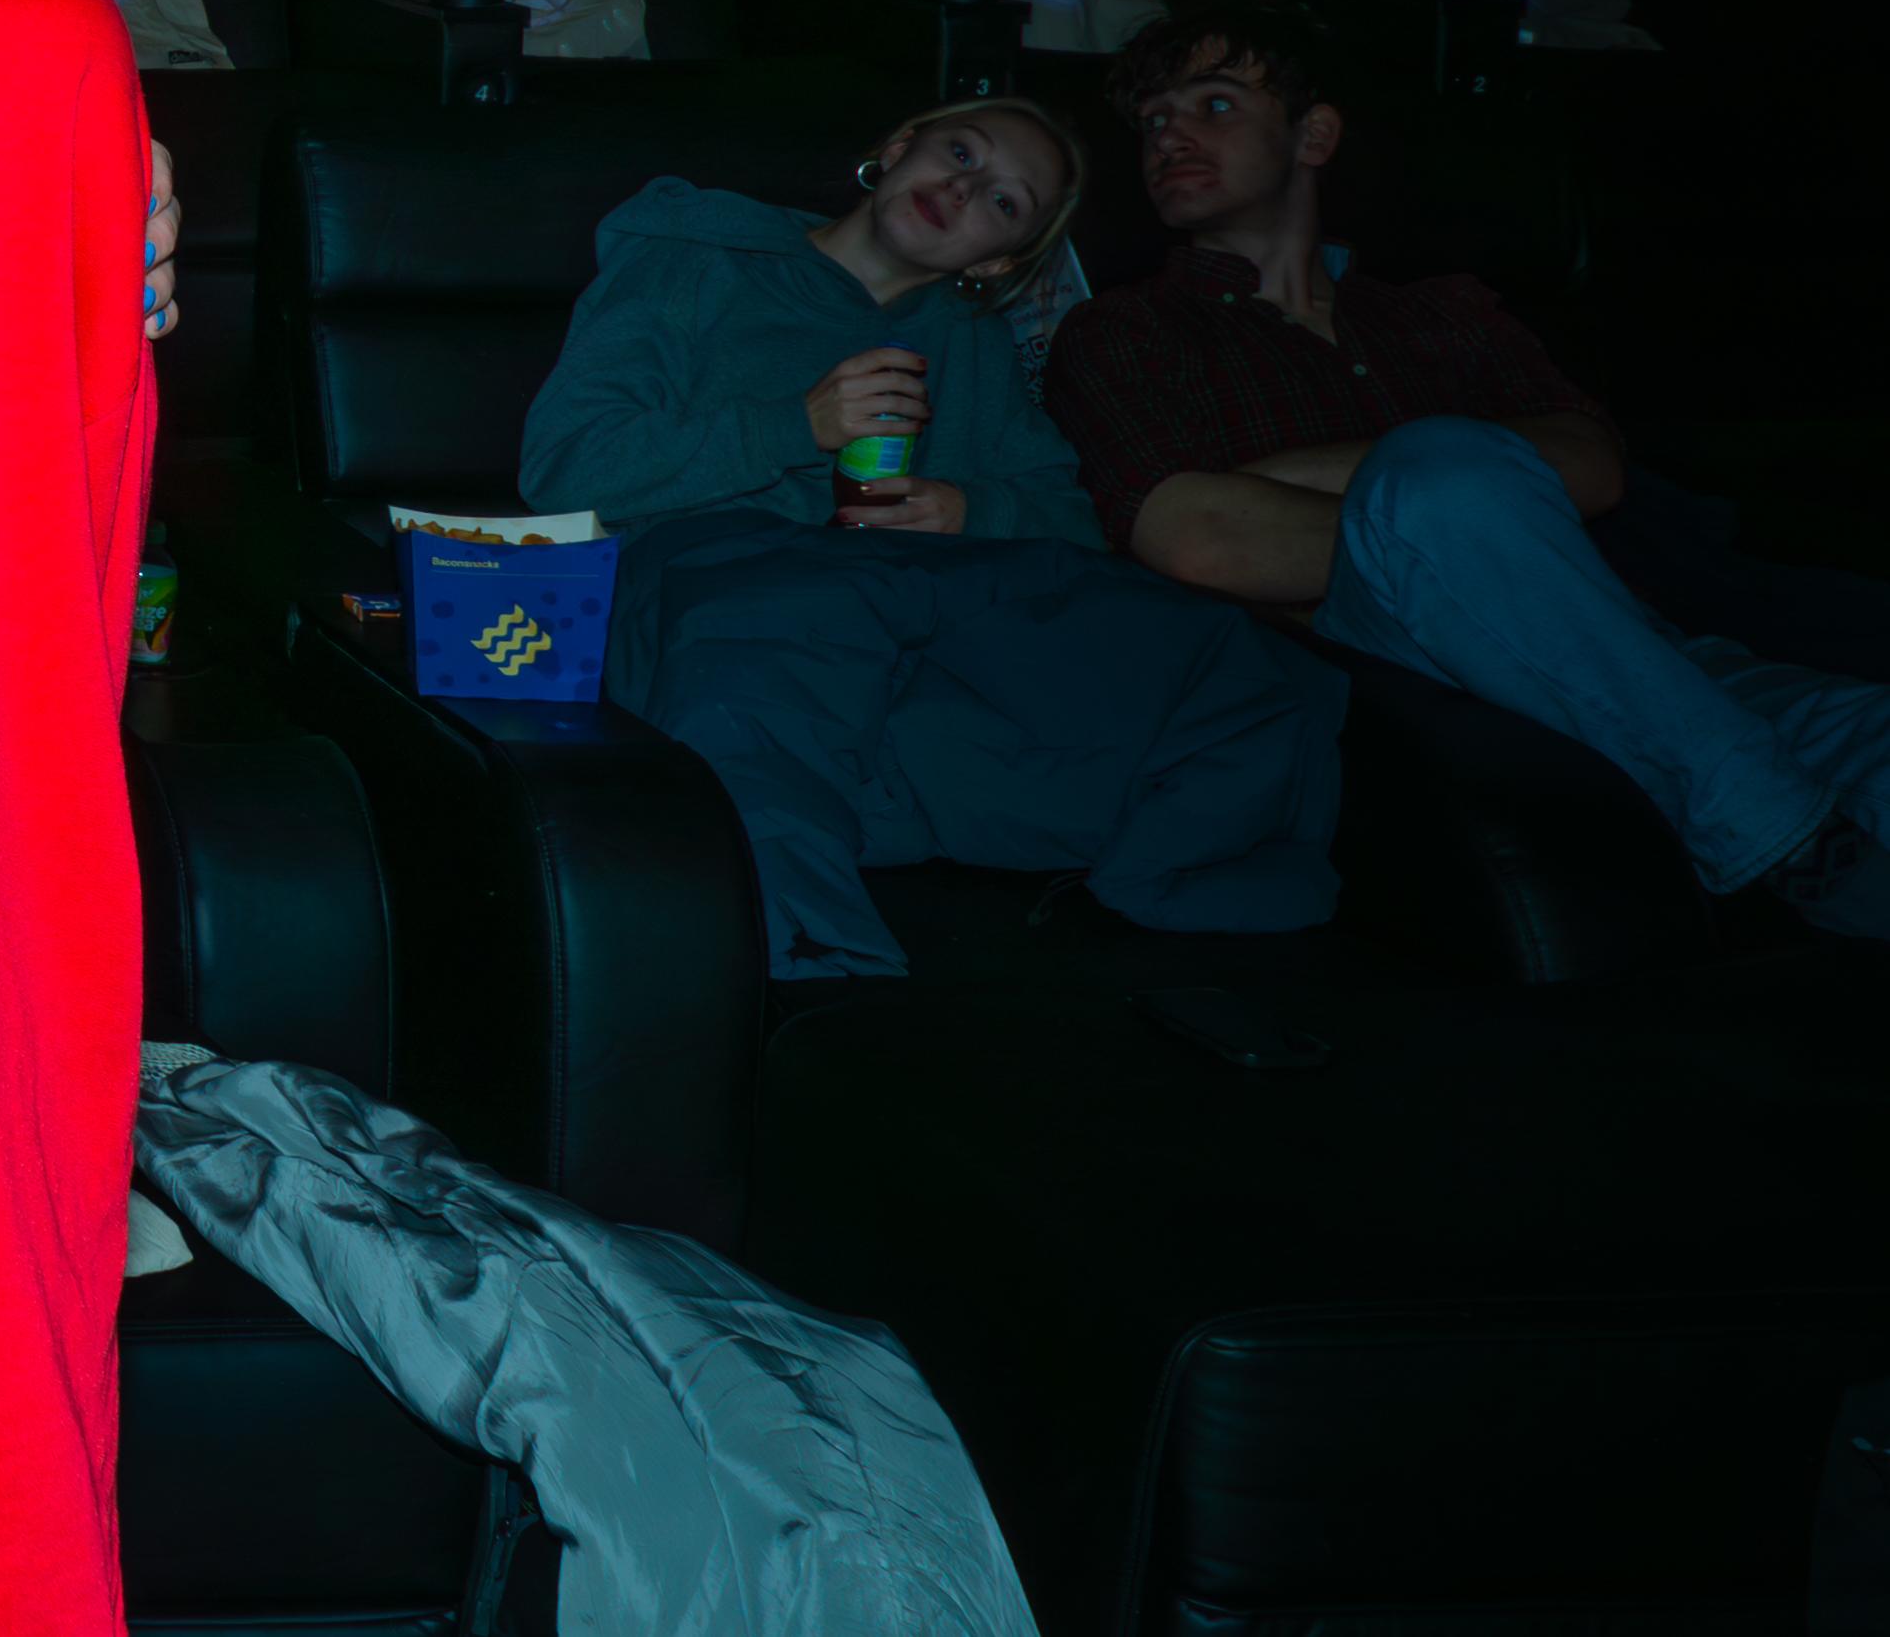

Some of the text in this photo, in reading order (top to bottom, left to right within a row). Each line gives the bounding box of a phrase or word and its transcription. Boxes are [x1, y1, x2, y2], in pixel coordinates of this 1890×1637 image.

[474, 83, 489, 103] 4
[975, 78, 990, 97] 3
[1472, 74, 1486, 94] 2
[431, 556, 500, 569] Baconsnacks
